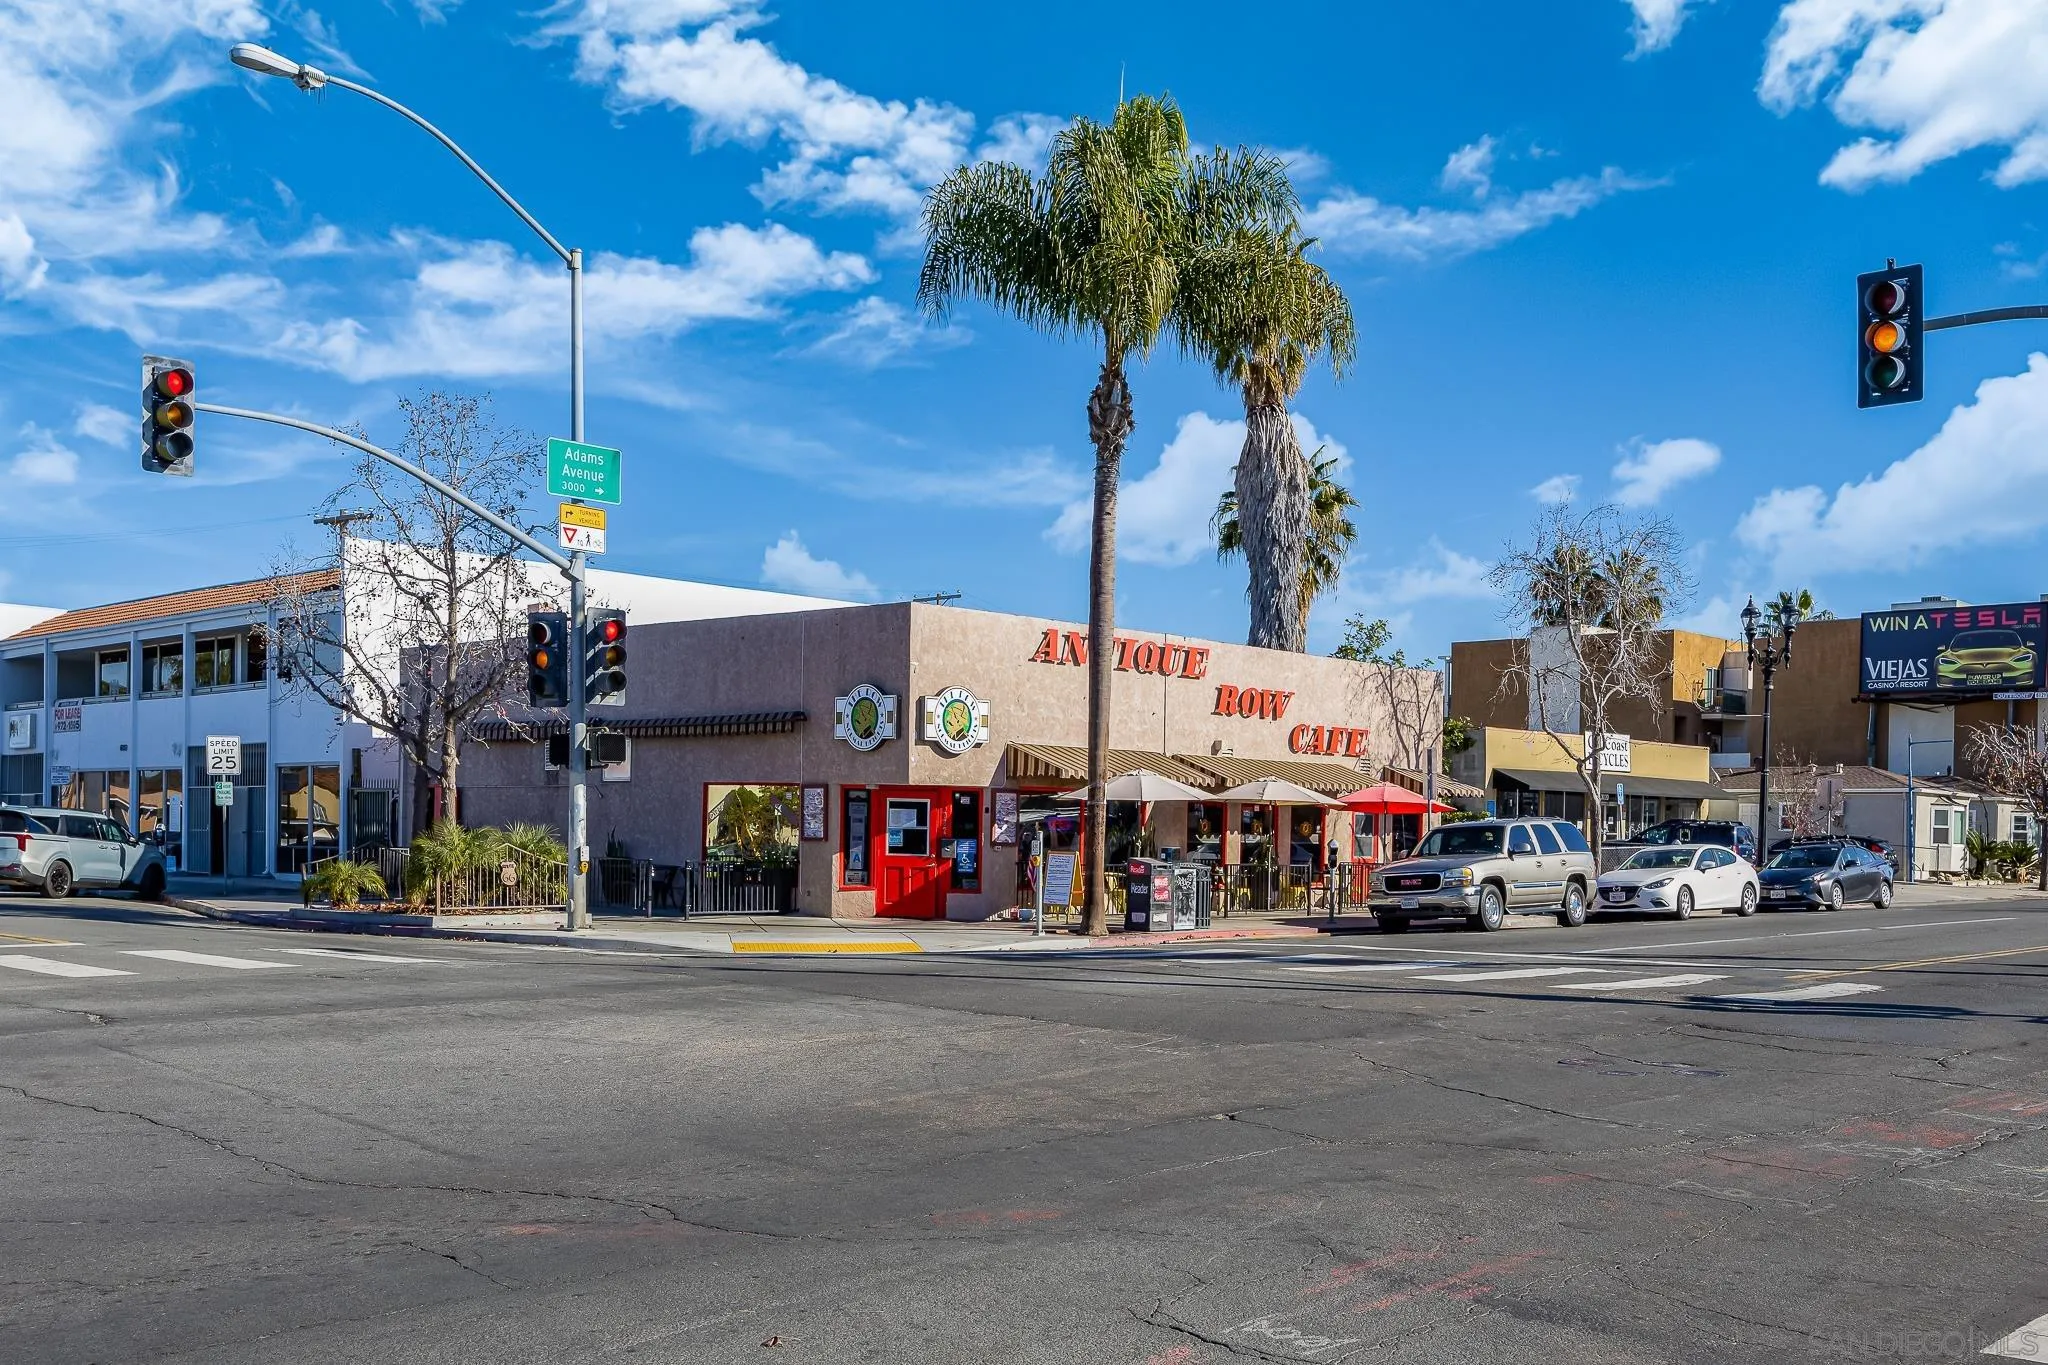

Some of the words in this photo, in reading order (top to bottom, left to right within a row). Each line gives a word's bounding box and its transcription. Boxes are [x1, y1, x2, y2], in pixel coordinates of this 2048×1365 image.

[564, 447, 604, 466] Adams
[562, 464, 604, 482] Avenue
[562, 481, 585, 493] 3000
[579, 510, 600, 518] TURNING
[579, 517, 601, 527] VEHICLES
[1869, 615, 1909, 632] WIN
[1913, 614, 1928, 630] A
[1929, 608, 2041, 629] TESLA
[1865, 658, 1928, 683] VIEJAS
[1214, 684, 1295, 720] ROW
[55, 709, 65, 720] FOR
[65, 707, 81, 719] LEASE
[1290, 723, 1369, 757] CAFE
[1605, 741, 1628, 751] Coast
[211, 756, 237, 769] 25
[853, 853, 861, 863] A
[502, 873, 516, 882] 66
[1400, 878, 1422, 886] GMC
[1130, 883, 1148, 894] Reader
